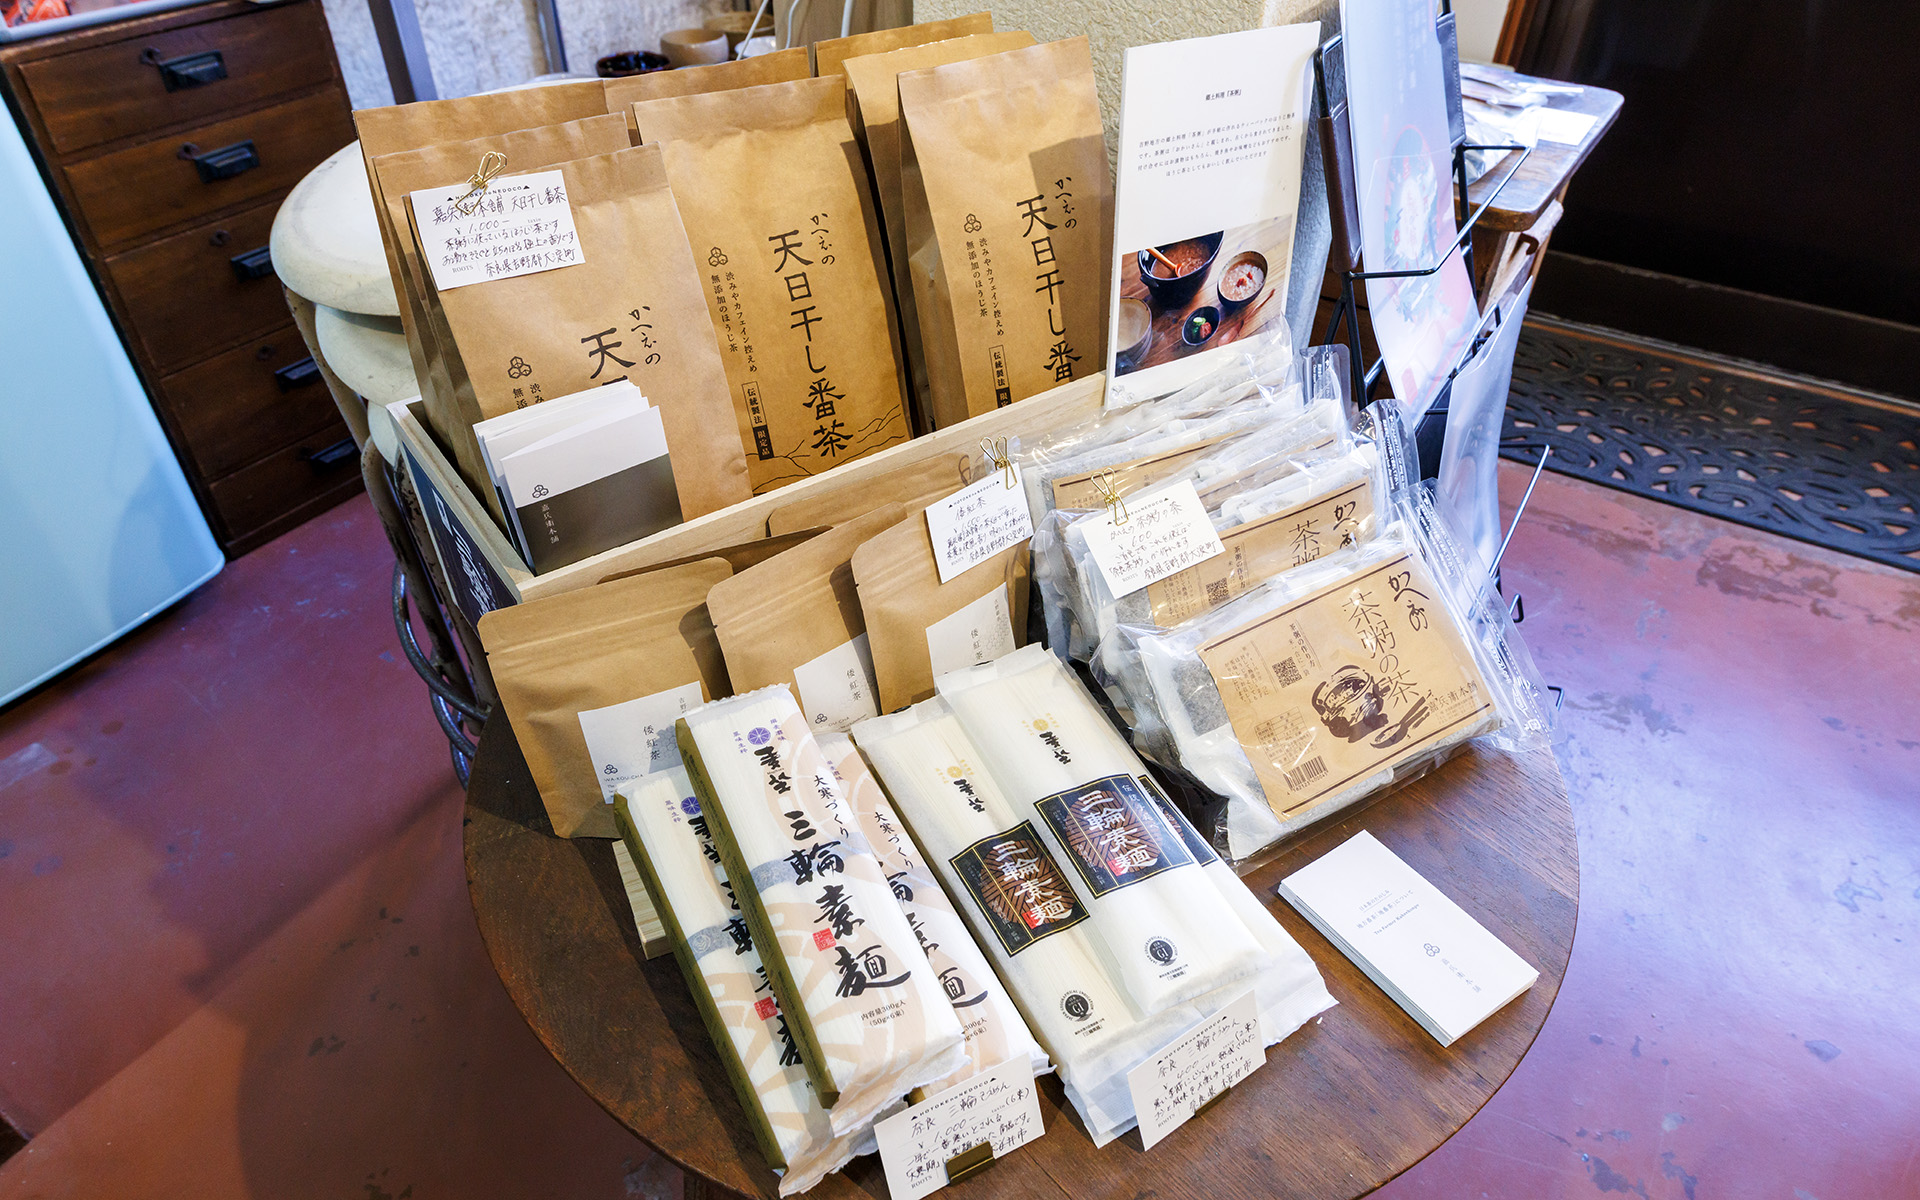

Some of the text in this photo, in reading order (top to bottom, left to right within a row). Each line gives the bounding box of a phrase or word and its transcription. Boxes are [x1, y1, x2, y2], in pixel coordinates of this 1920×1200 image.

[512, 186, 566, 212] 天日干し番茶
[452, 264, 473, 273] ROOTS
[966, 240, 988, 318] 無添加のほうじ茶
[979, 238, 1004, 337] 渋みやカフェイン控えめ
[711, 275, 738, 353] 無添加のほうじ茶
[725, 271, 758, 373] 渋みやカフェイン控えめ
[768, 230, 854, 457] 天日干し番茶
[746, 388, 762, 424] 伝統製法
[1342, 592, 1420, 706] 茶粥の茶
[644, 724, 660, 760] 倭紅茶
[814, 775, 848, 839] 大寒づくり
[874, 812, 914, 870] 大寒づくり
[1157, 948, 1168, 958] GI
[861, 1000, 906, 1020] 内容量300g入
[1072, 1002, 1084, 1014] GI
[1158, 1059, 1177, 1078] 奈良
[912, 1083, 1010, 1138] 奈良 三輪そうめん
[912, 1175, 932, 1188] ROOTS
